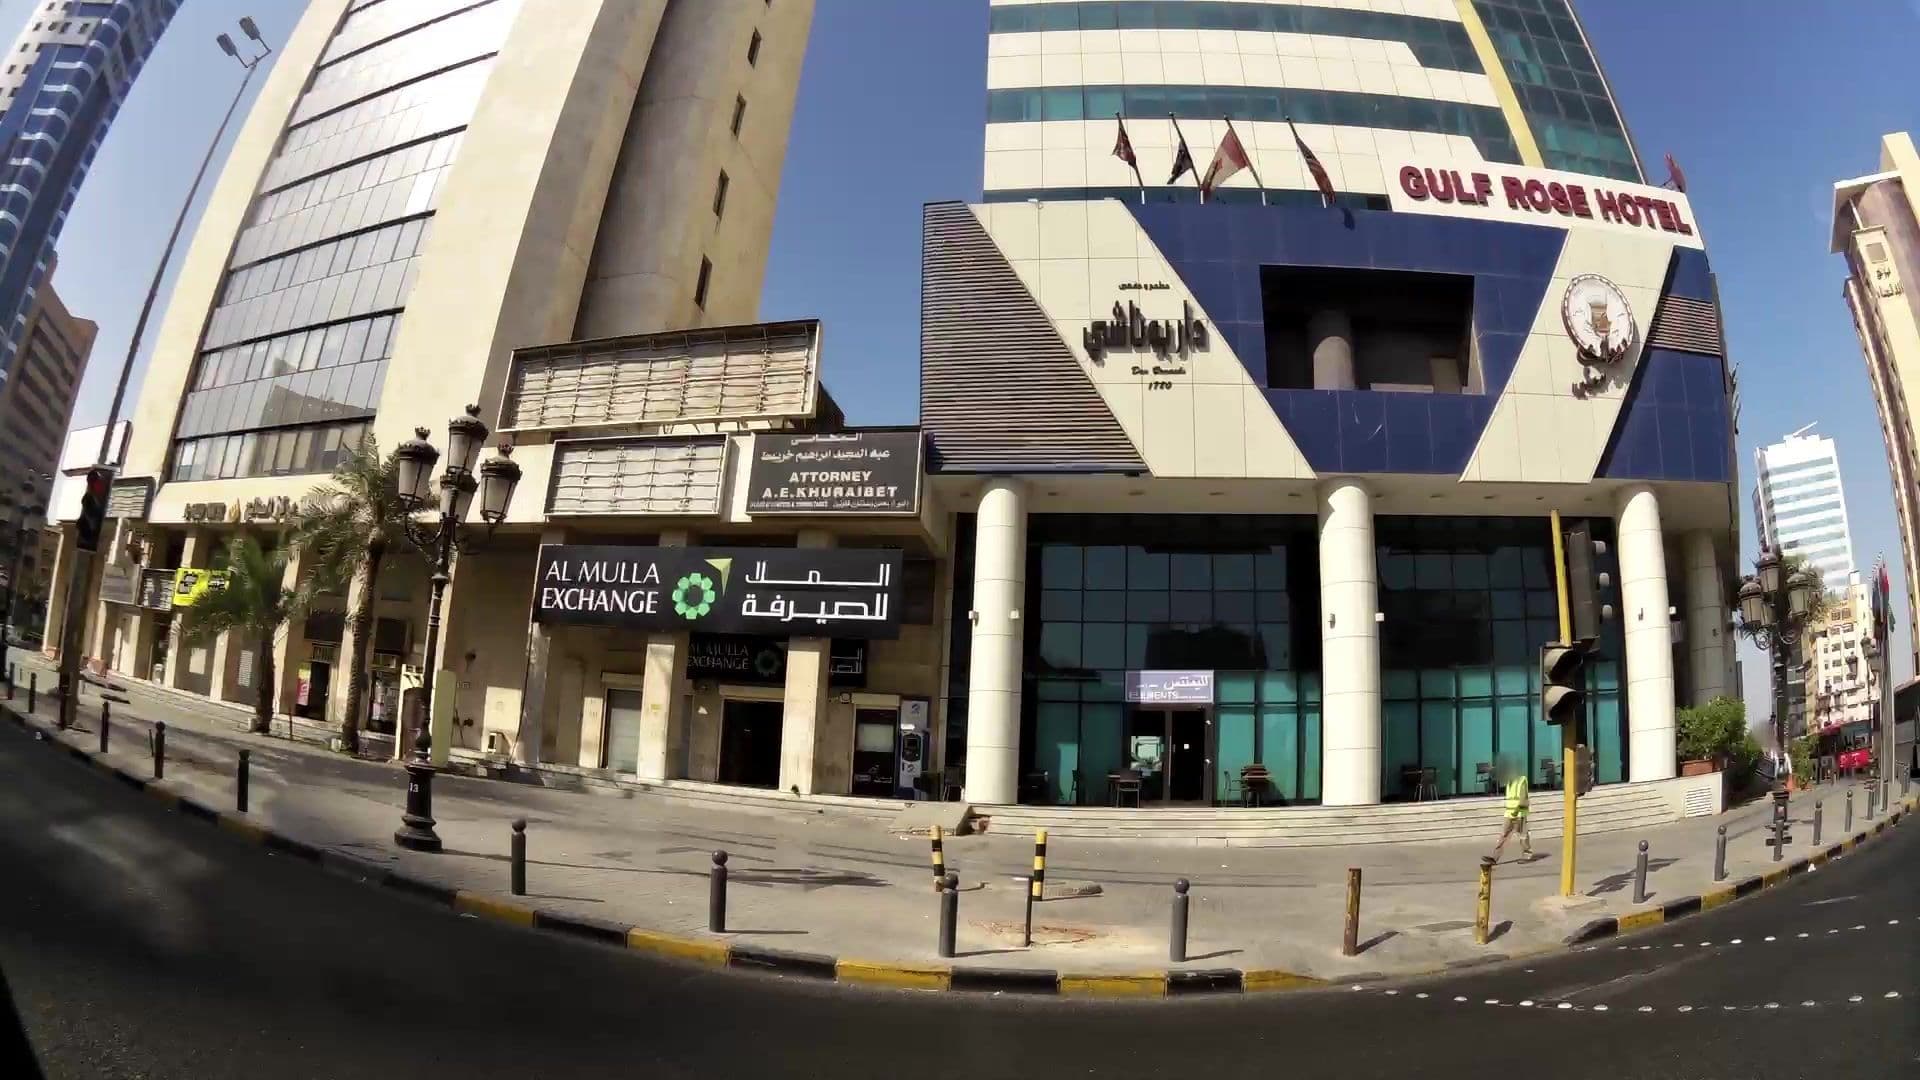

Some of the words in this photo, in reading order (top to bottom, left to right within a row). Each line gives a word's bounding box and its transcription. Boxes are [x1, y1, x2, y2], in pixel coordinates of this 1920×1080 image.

[1399, 165, 1494, 208] GULF
[1502, 175, 1593, 220] ROSE
[1594, 188, 1693, 236] HOTEL
[788, 471, 873, 483] ATTORNEY
[545, 560, 572, 582] AL
[578, 561, 660, 584] MULLA
[745, 560, 891, 587] الملا
[541, 587, 659, 614] EXCHANGE
